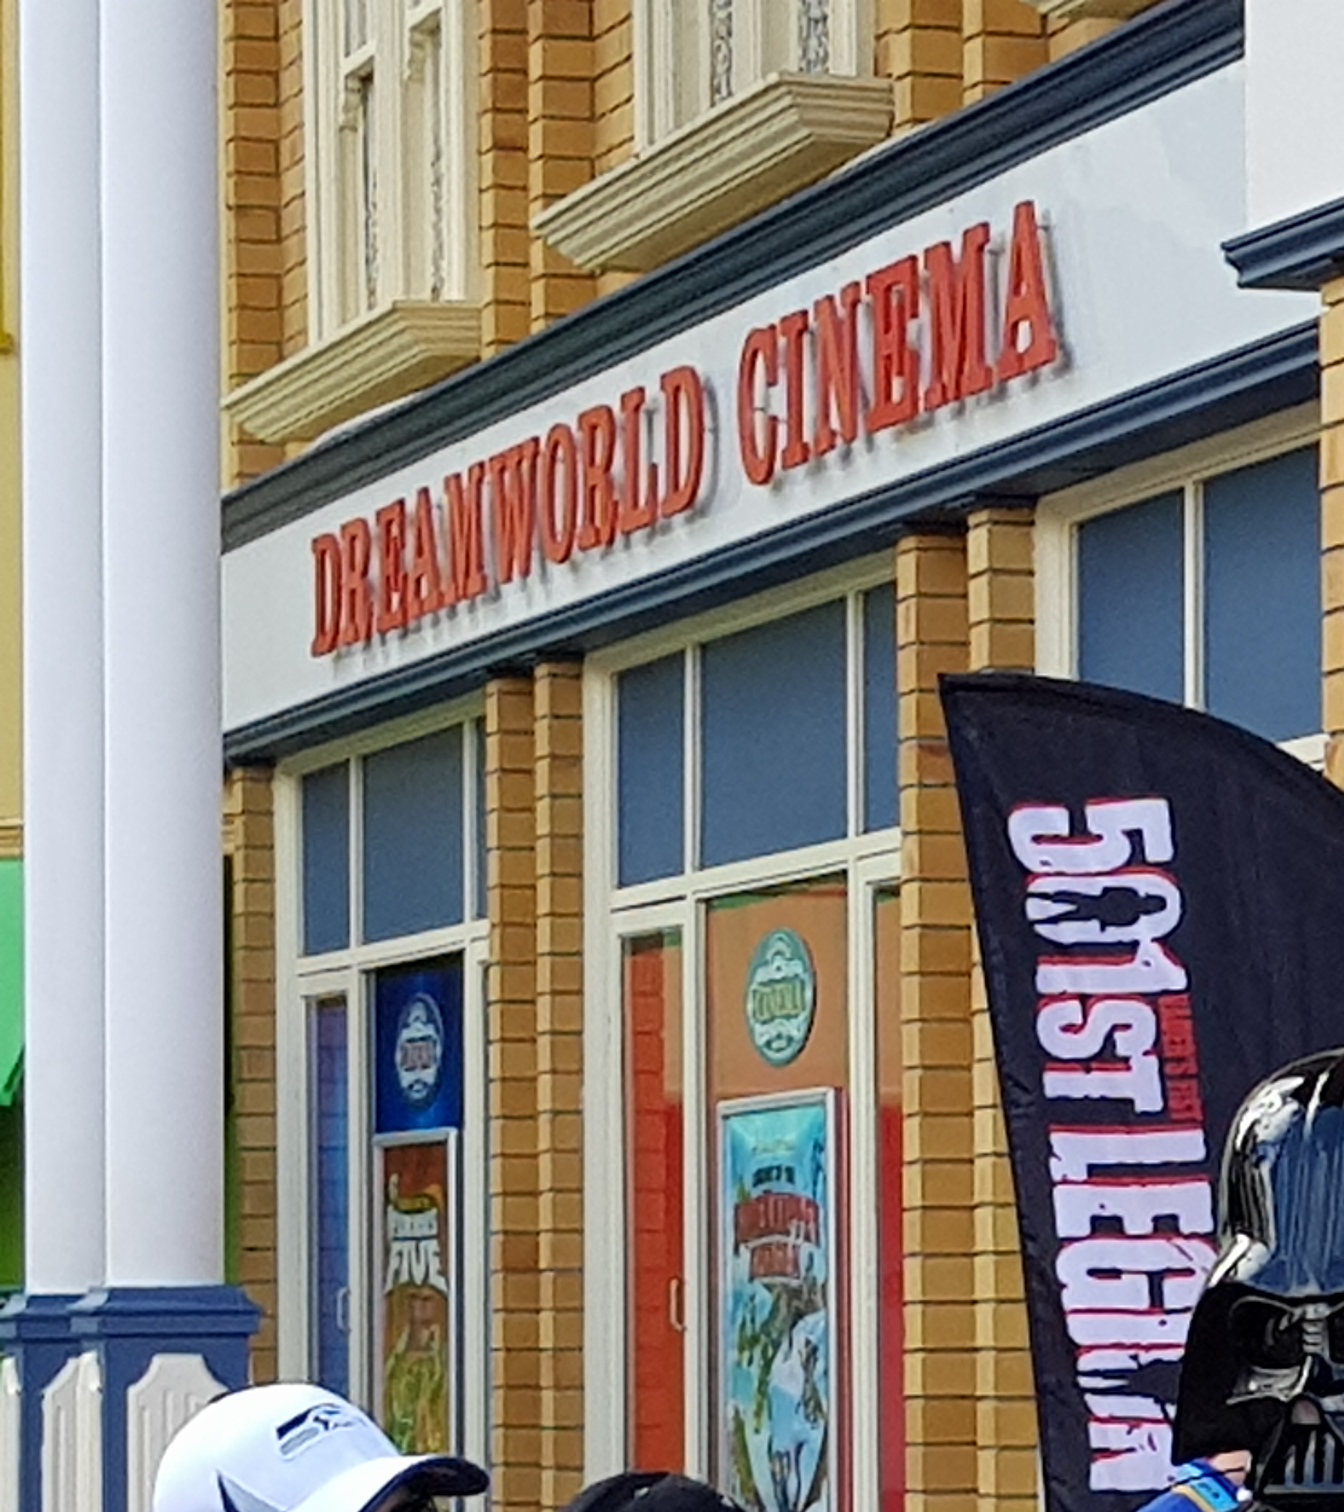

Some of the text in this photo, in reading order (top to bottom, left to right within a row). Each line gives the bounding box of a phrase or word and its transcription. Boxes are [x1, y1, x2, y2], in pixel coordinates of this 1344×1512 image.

[310, 200, 1059, 658] DREAMWORLD CINEMA
[1007, 797, 1190, 1114] 501ST
